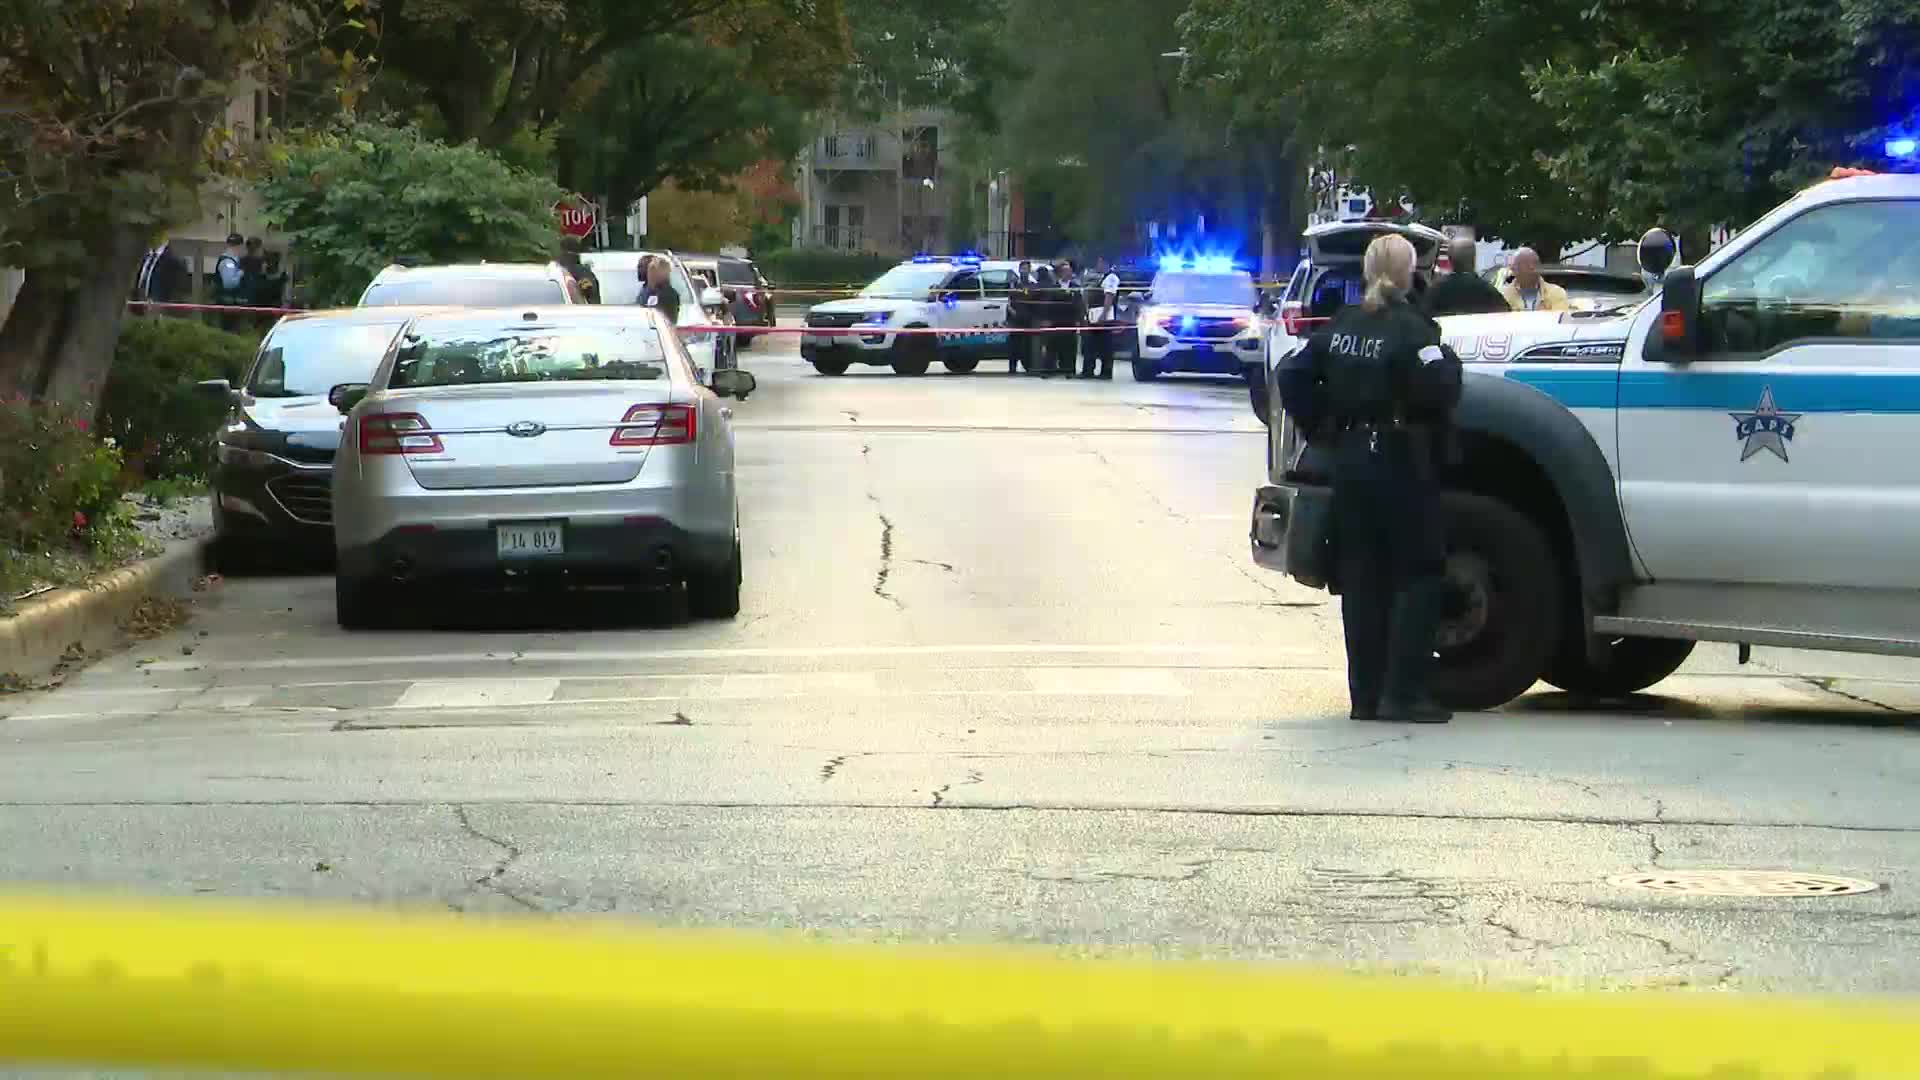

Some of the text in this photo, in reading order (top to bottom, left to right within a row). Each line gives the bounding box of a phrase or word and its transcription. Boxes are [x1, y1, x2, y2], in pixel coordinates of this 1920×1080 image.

[1329, 332, 1384, 359] POLICE
[1741, 419, 1790, 434] CAPS
[512, 531, 526, 549] 14
